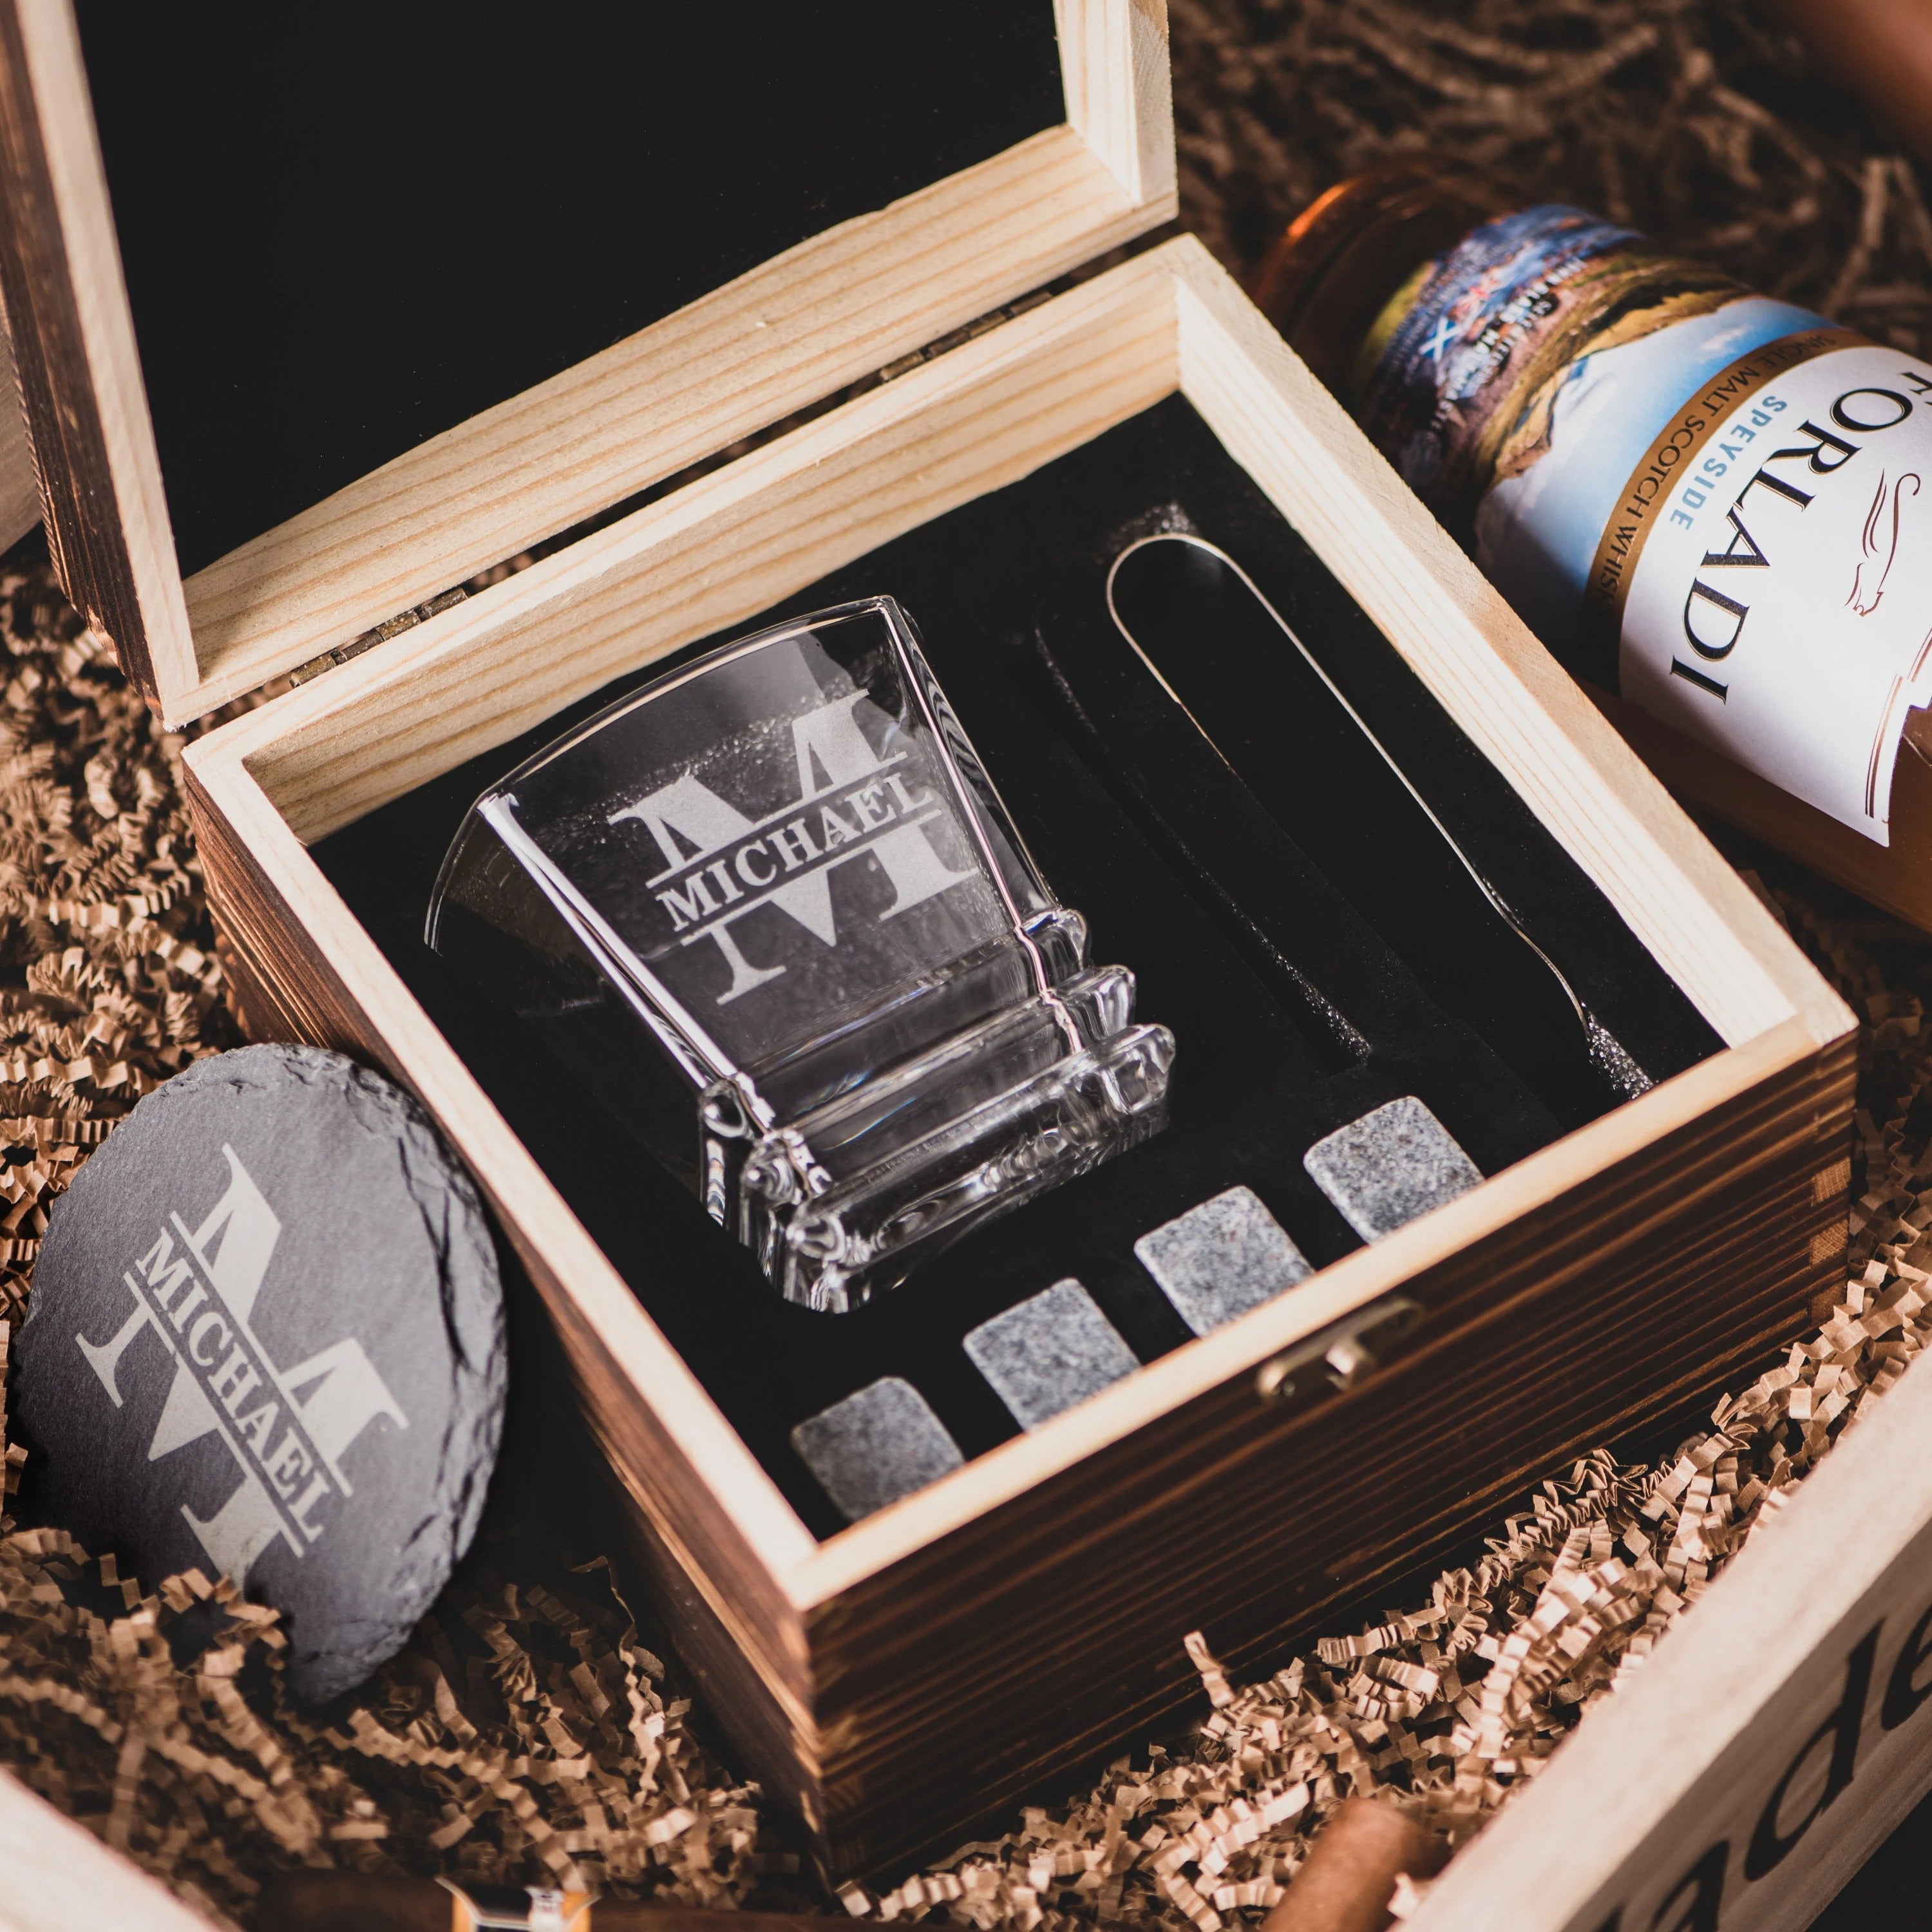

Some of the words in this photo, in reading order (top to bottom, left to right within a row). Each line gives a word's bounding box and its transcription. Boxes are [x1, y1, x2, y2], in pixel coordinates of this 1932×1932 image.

[1701, 366, 1761, 417] MALT
[1754, 335, 1836, 370] SINGLE
[1627, 415, 1705, 520] SCOTCH
[1670, 395, 1787, 530] SPEYSIDE
[655, 772, 934, 932] MICHAEL
[135, 1227, 330, 1542] MICHAEL
